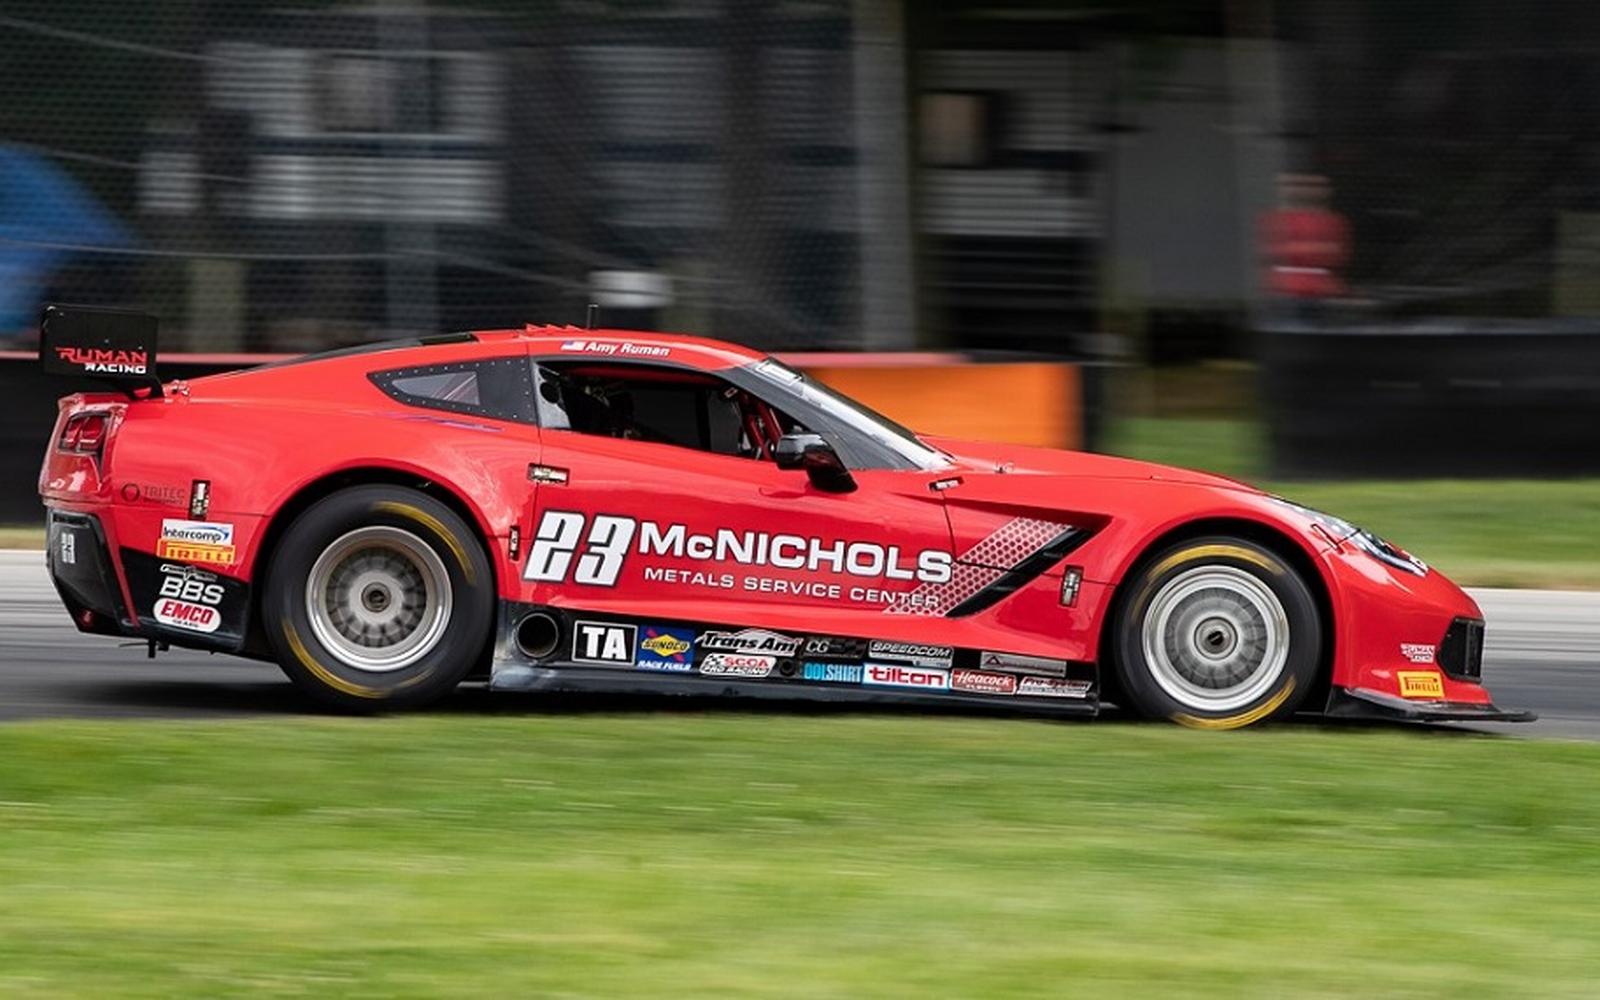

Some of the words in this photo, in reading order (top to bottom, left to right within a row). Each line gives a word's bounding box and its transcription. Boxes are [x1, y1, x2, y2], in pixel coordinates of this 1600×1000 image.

[56, 346, 148, 366] RUMAN
[585, 342, 619, 355] Amy
[621, 343, 670, 356] Ruman
[84, 362, 147, 374] RACING
[144, 485, 185, 499] TRITEC
[164, 525, 222, 544] Intercomp
[522, 510, 638, 587] 23
[638, 521, 954, 585] McNICHOLS
[159, 575, 226, 606] BBS
[643, 567, 736, 589] METALS
[743, 577, 842, 599] SERVICE
[849, 587, 940, 609] CENTER
[161, 601, 214, 625] EMCO
[582, 625, 628, 660] TA
[643, 639, 688, 652] SUNOCO
[702, 632, 759, 650] Trans
[758, 638, 796, 653] Am
[806, 640, 831, 654] CG
[872, 641, 950, 658] SPEEDCOM
[637, 660, 663, 671] RACE
[724, 657, 769, 669] SCCA
[868, 665, 944, 686] tilton
[956, 670, 1012, 686] Heacock
